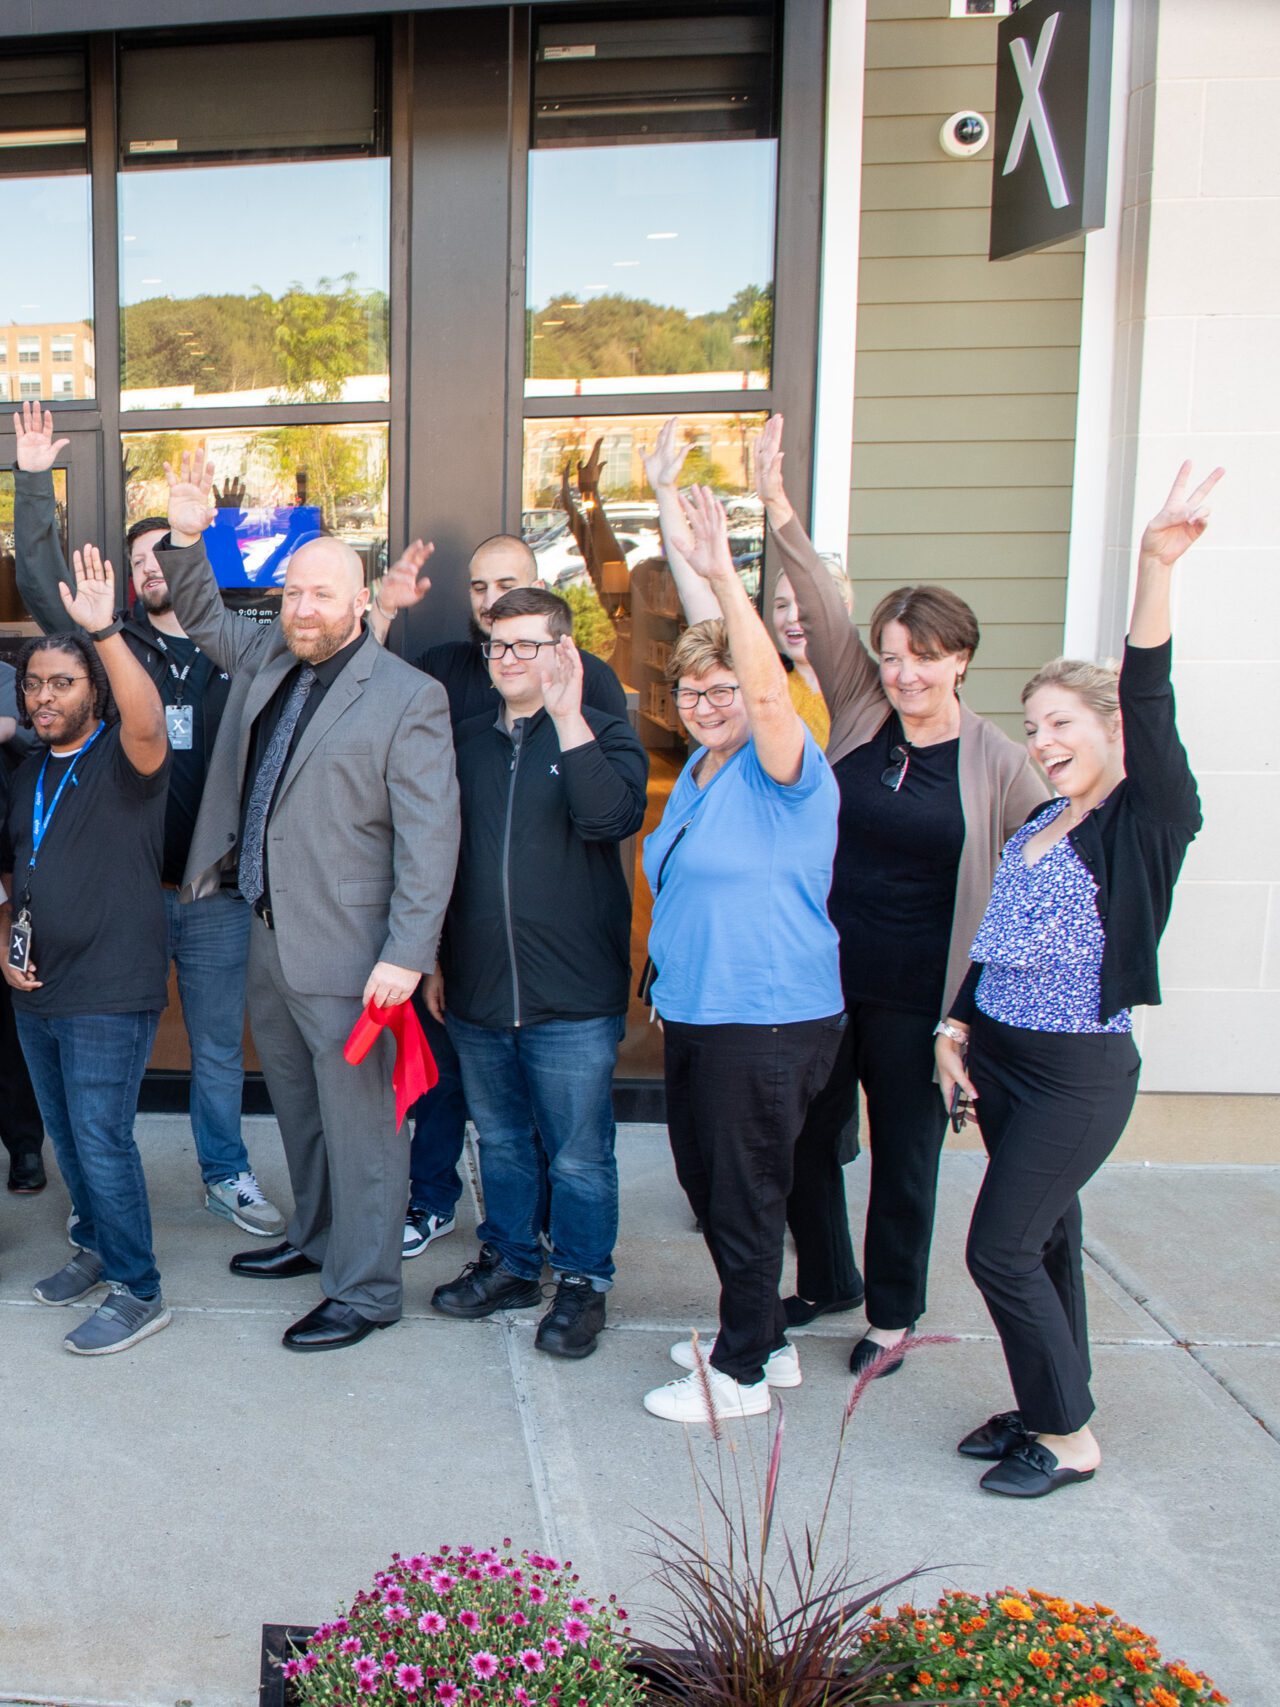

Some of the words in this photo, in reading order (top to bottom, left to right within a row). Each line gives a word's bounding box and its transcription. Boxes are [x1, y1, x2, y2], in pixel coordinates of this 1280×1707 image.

[1002, 11, 1070, 209] X
[238, 608, 258, 616] 9:00
[173, 719, 186, 733] X
[12, 935, 24, 955] X
